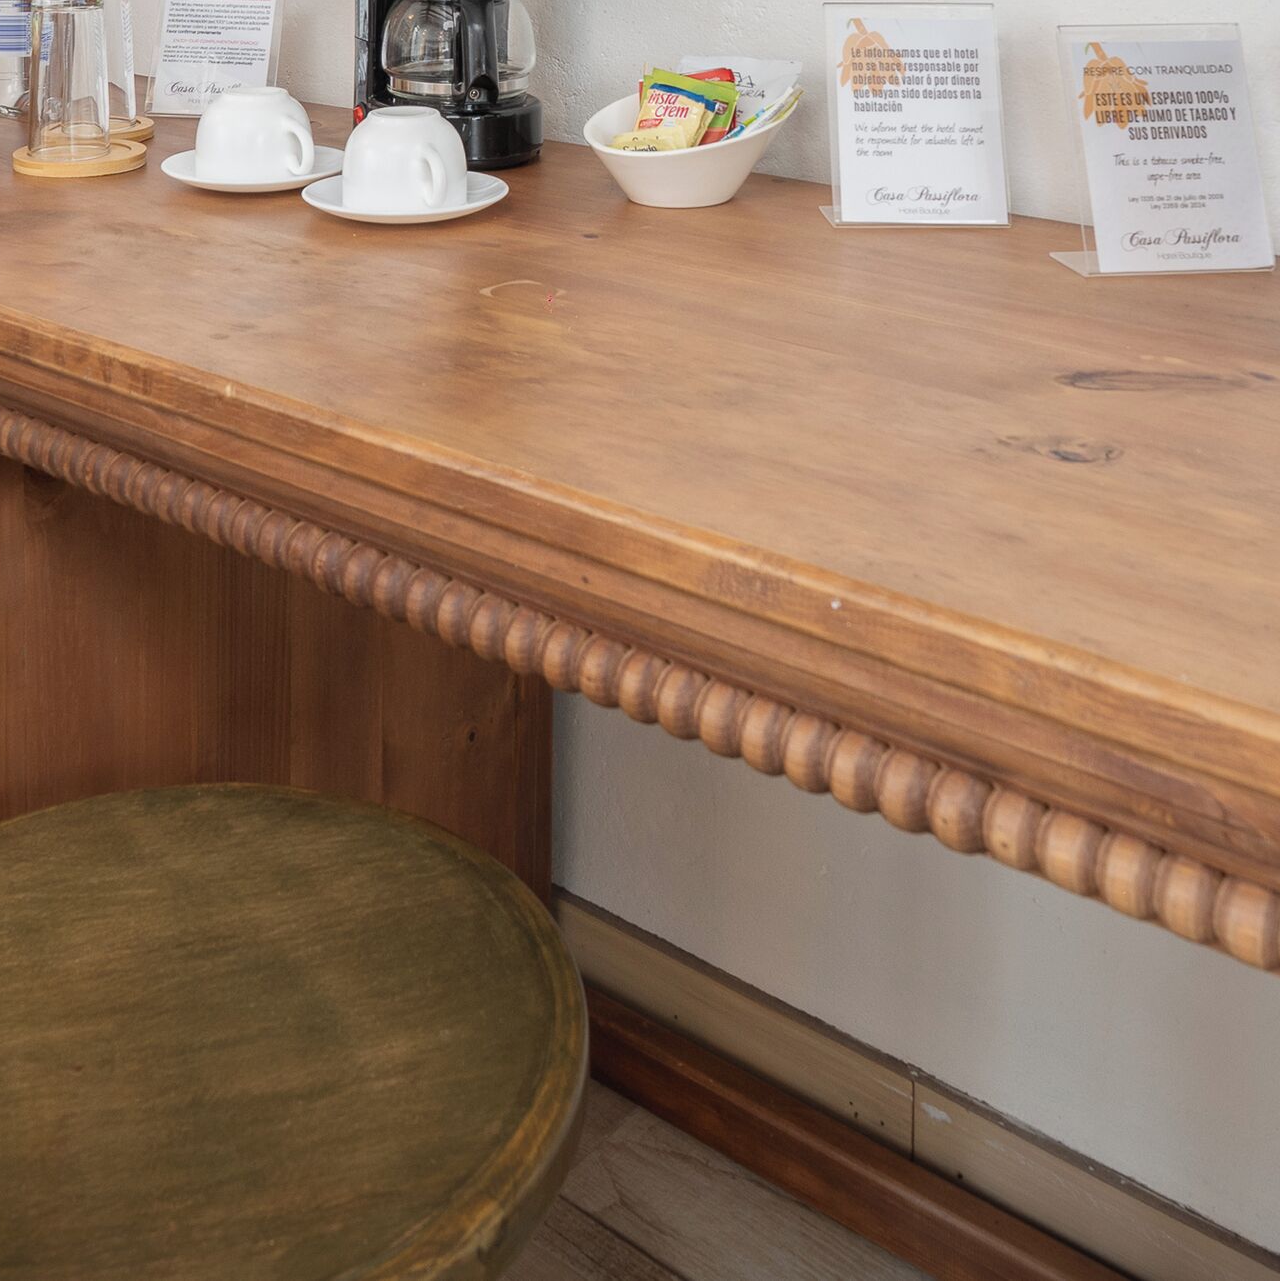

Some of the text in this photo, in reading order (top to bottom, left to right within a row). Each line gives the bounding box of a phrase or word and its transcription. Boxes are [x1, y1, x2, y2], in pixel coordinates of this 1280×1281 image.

[851, 47, 978, 61] Le informamos que el hotel
[852, 61, 979, 74] no se hace responsable por
[1083, 64, 1233, 77] RESPIRE CON TRANQUILIDAD
[853, 75, 886, 88] objetos
[889, 75, 900, 85] de
[902, 75, 924, 85] valor
[934, 77, 949, 88] por
[951, 75, 980, 86] dinero
[648, 90, 679, 105] insta
[853, 89, 982, 102] que hayan sido dejados en la
[1095, 90, 1229, 107] ESTE ES UN ESPACIO 100%
[655, 105, 689, 118] crem
[854, 101, 902, 112] habitación
[1095, 107, 1236, 124] LIBRE DE HUMO DE TABACO Y
[855, 122, 983, 133] We inform that the hotel cannot
[1129, 125, 1207, 140] SUS DERIVADOS
[910, 134, 922, 146] for
[961, 134, 974, 146] left
[856, 148, 892, 157] the room
[1113, 153, 1129, 166] This
[1133, 157, 1140, 166] is
[1151, 156, 1178, 165] tobacco
[1147, 169, 1201, 186] vape-free area
[869, 186, 980, 207] Casa Passiflora
[1124, 227, 1242, 251] Casa Passiflora
